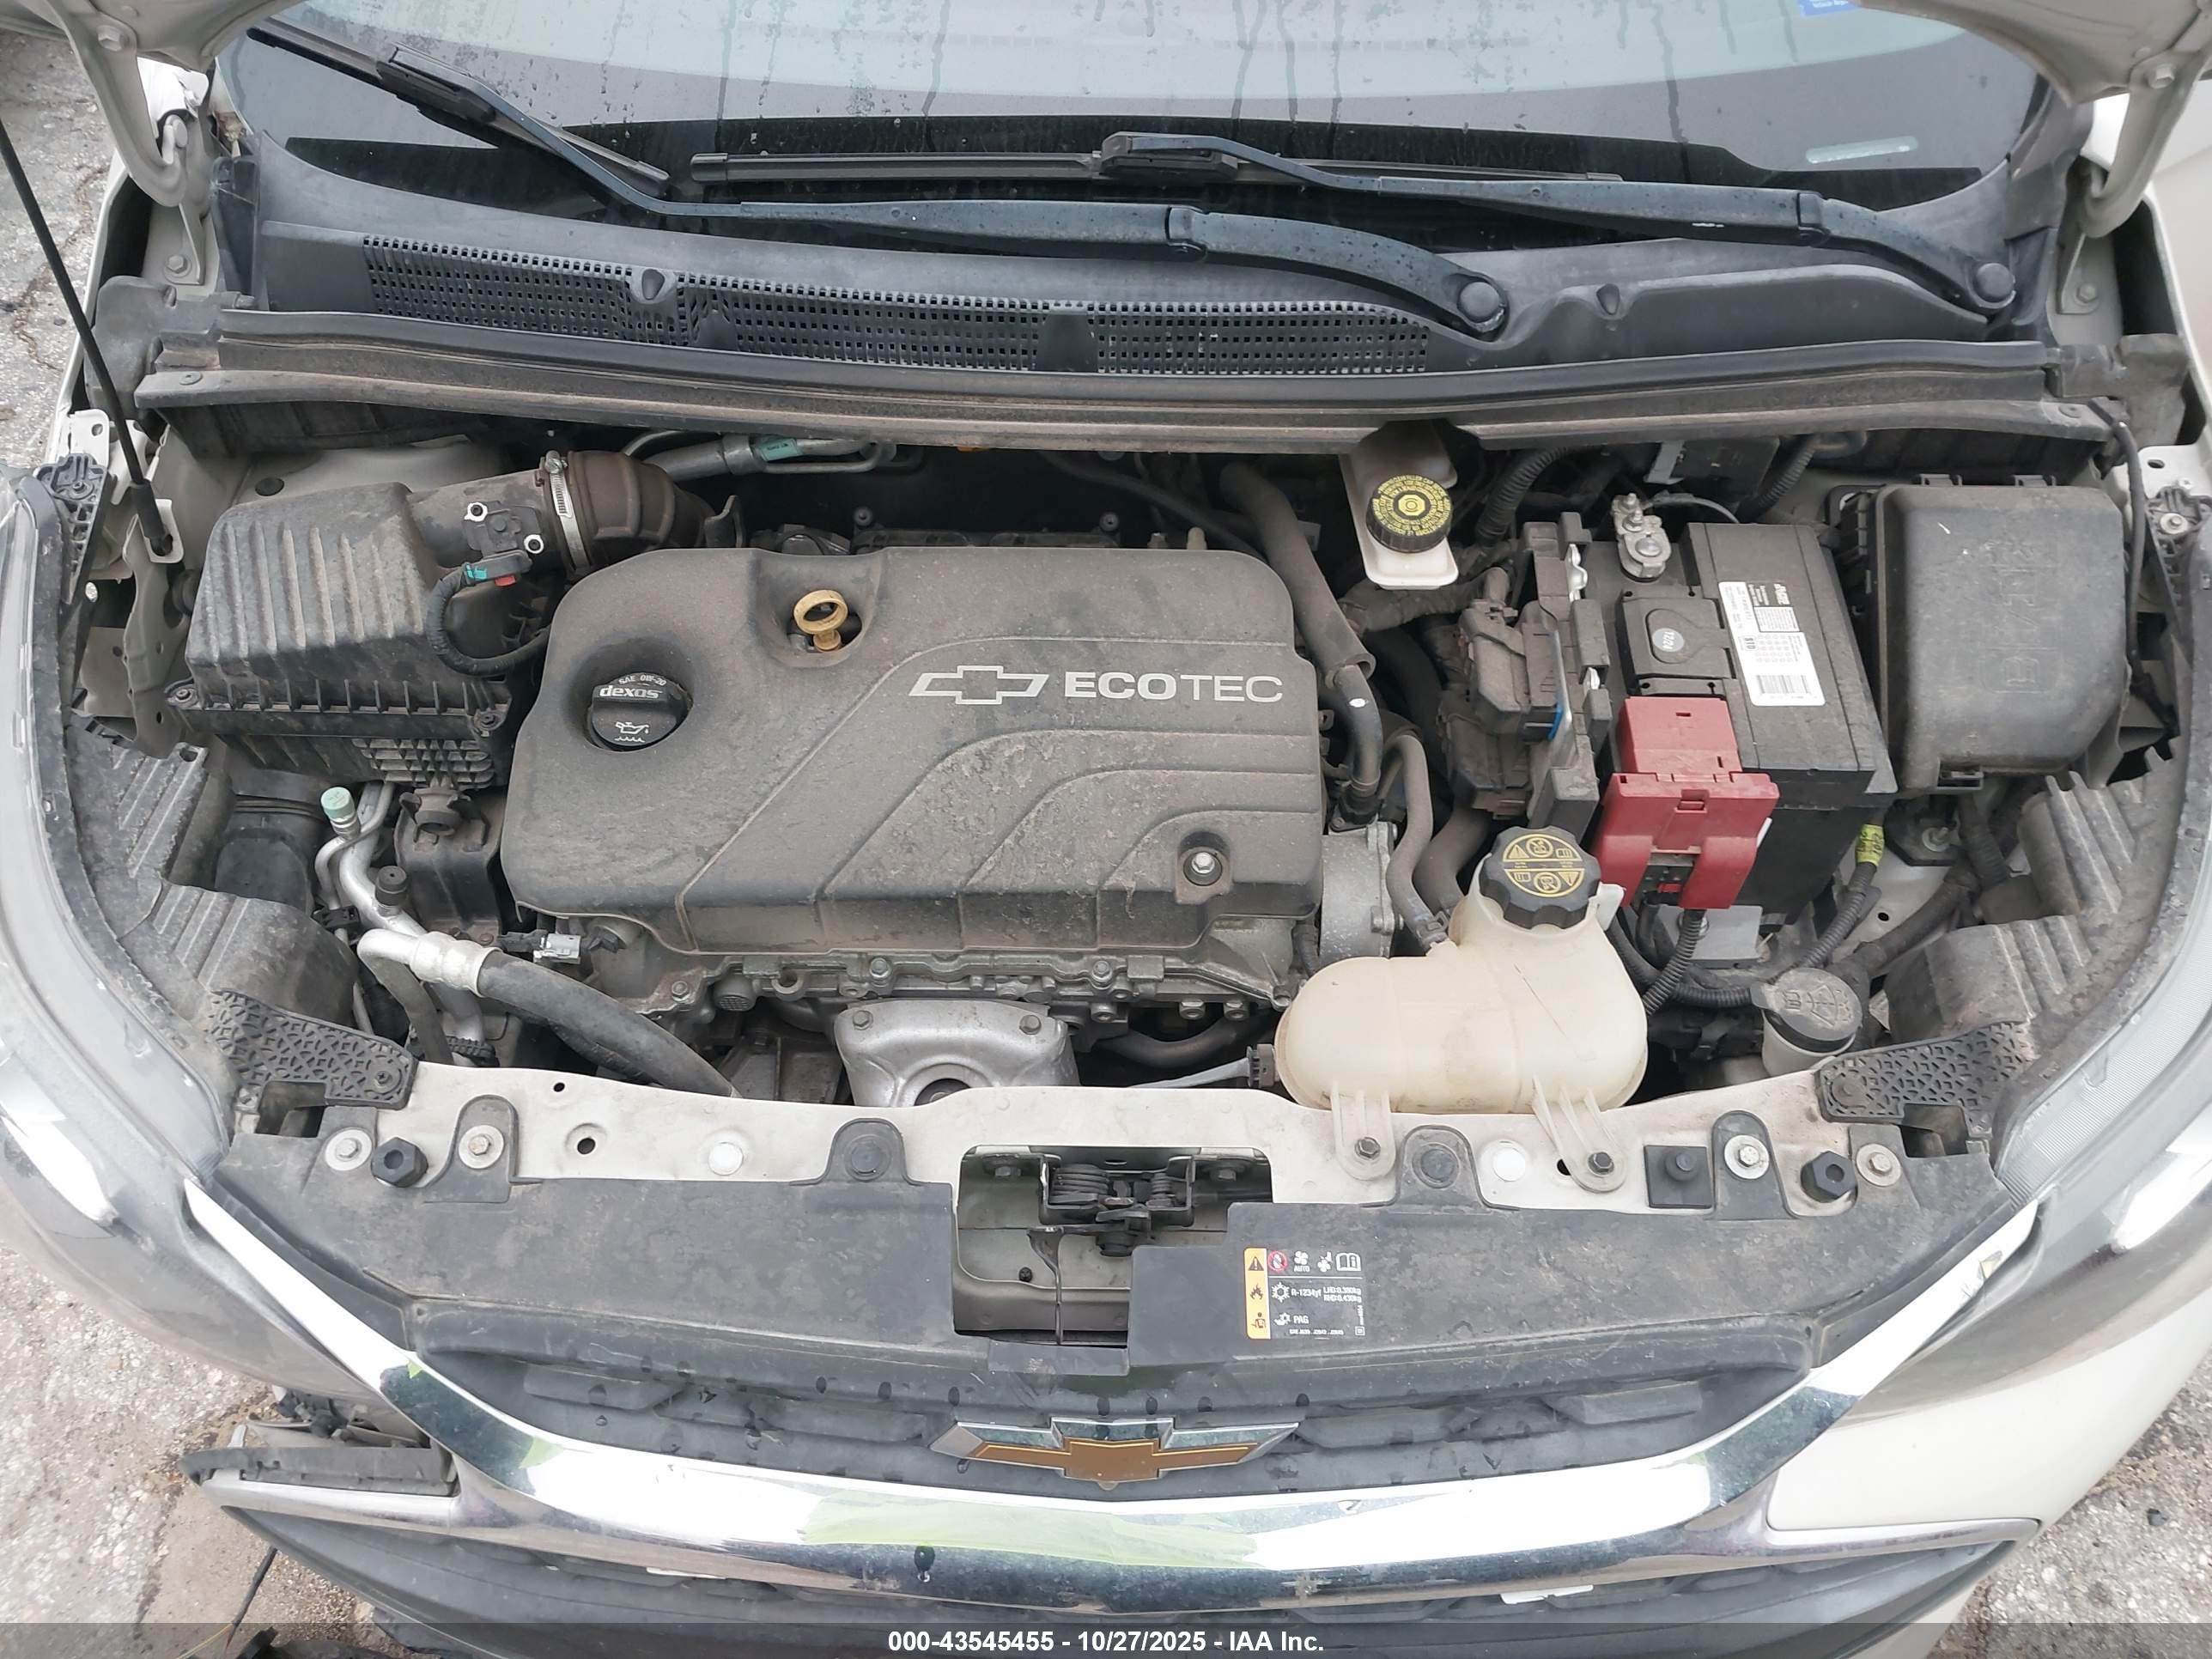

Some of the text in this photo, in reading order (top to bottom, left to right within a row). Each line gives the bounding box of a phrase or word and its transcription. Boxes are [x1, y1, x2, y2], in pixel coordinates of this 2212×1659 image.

[618, 675, 636, 685] SAE
[599, 685, 663, 699] dexos
[1064, 671, 1284, 703] ECOTEC
[1293, 1315, 1310, 1324] PAG
